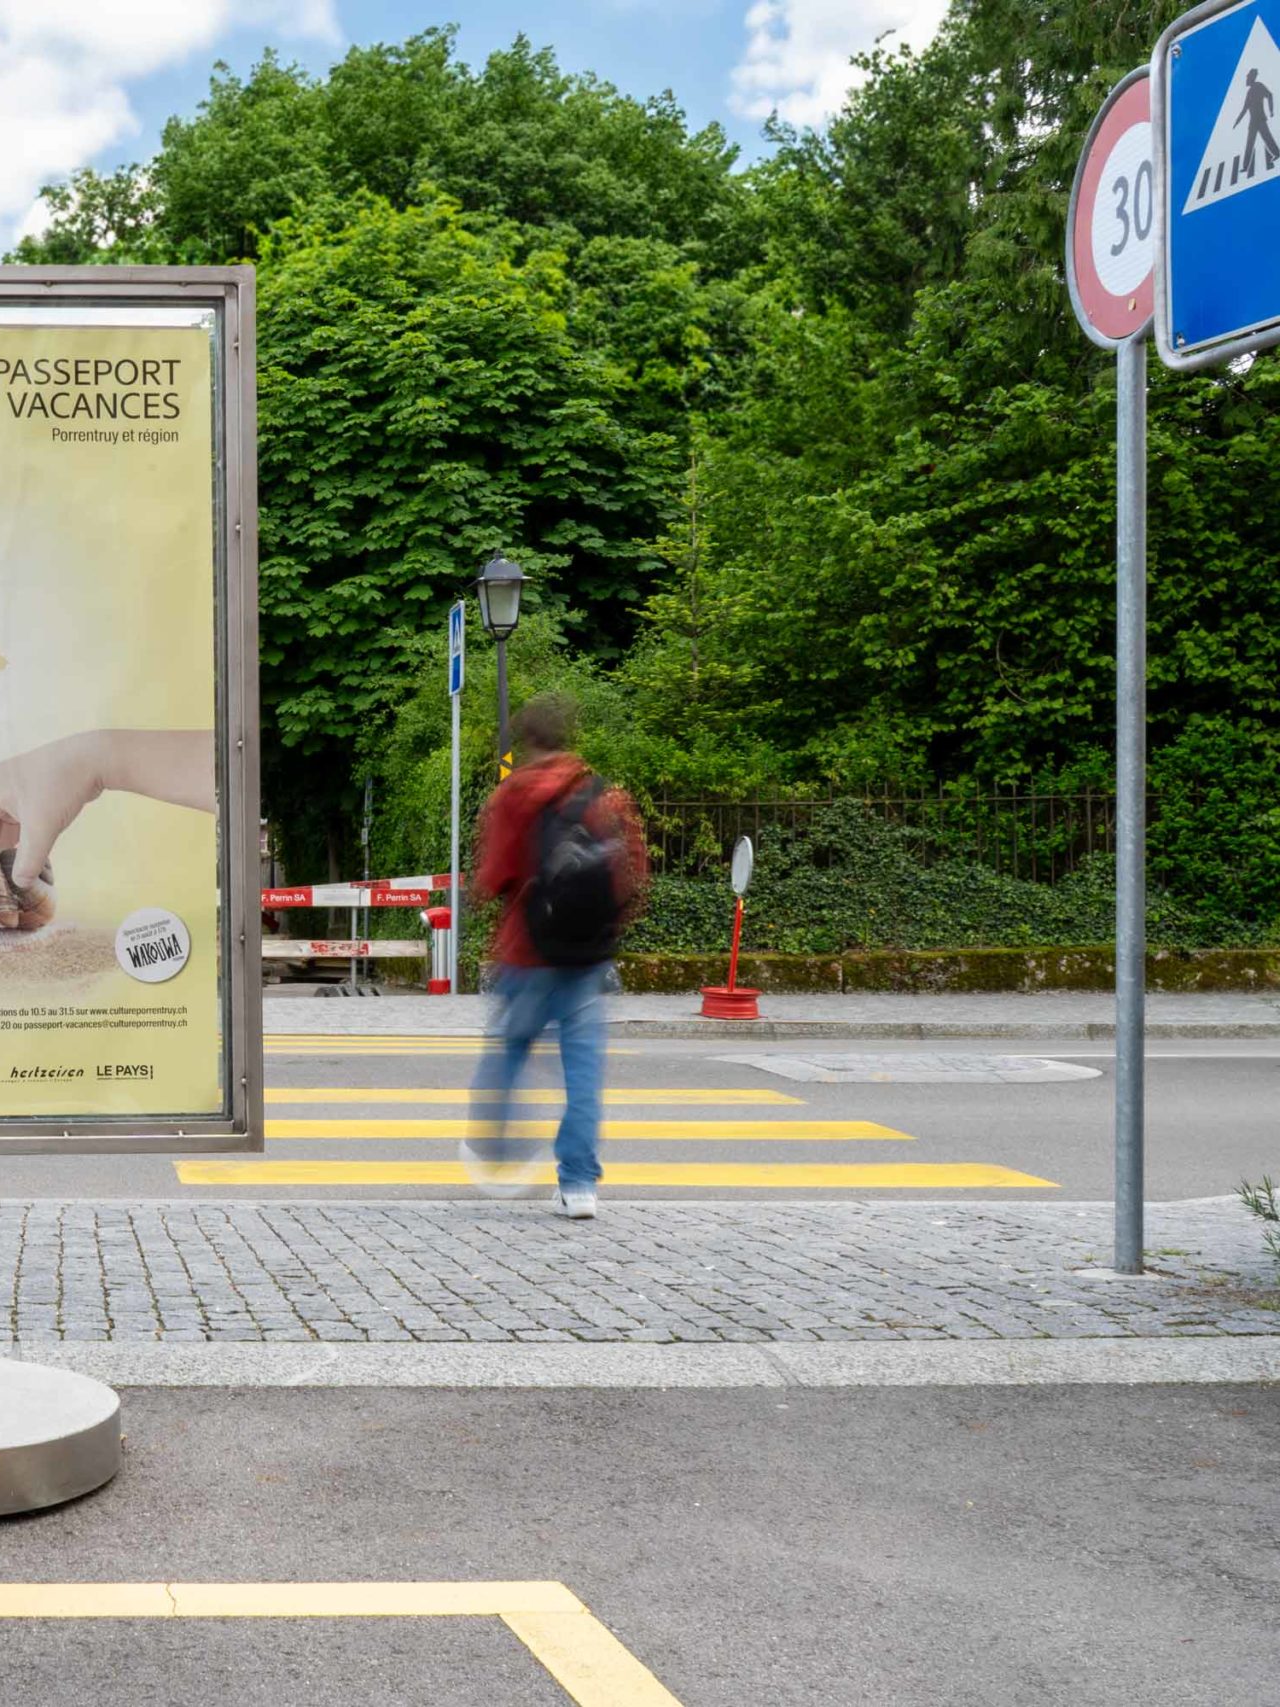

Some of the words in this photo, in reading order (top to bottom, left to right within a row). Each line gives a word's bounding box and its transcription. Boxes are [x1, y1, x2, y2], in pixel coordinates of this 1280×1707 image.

[1110, 160, 1153, 257] 30
[7, 392, 181, 420] VACANCES
[52, 428, 118, 445] Porrentruy
[122, 429, 134, 442] et
[138, 428, 179, 445] région
[270, 893, 293, 902] Perrin
[294, 892, 306, 902] SA
[376, 894, 385, 902] F.
[386, 893, 407, 902] Perrin
[407, 893, 422, 902] SA
[126, 933, 182, 968] WAKOUWA
[19, 1008, 29, 1016] du
[31, 1007, 46, 1016] 10.5
[60, 1007, 74, 1016] 31.5
[75, 1008, 88, 1016] sur
[89, 1006, 187, 1016] www.cultureporrentruy.ch
[0, 1020, 11, 1030] 20
[23, 1019, 188, 1030] passeport-vacances@cultureporrentruy.ch
[96, 1065, 112, 1076] LE
[115, 1065, 149, 1076] PAYS
